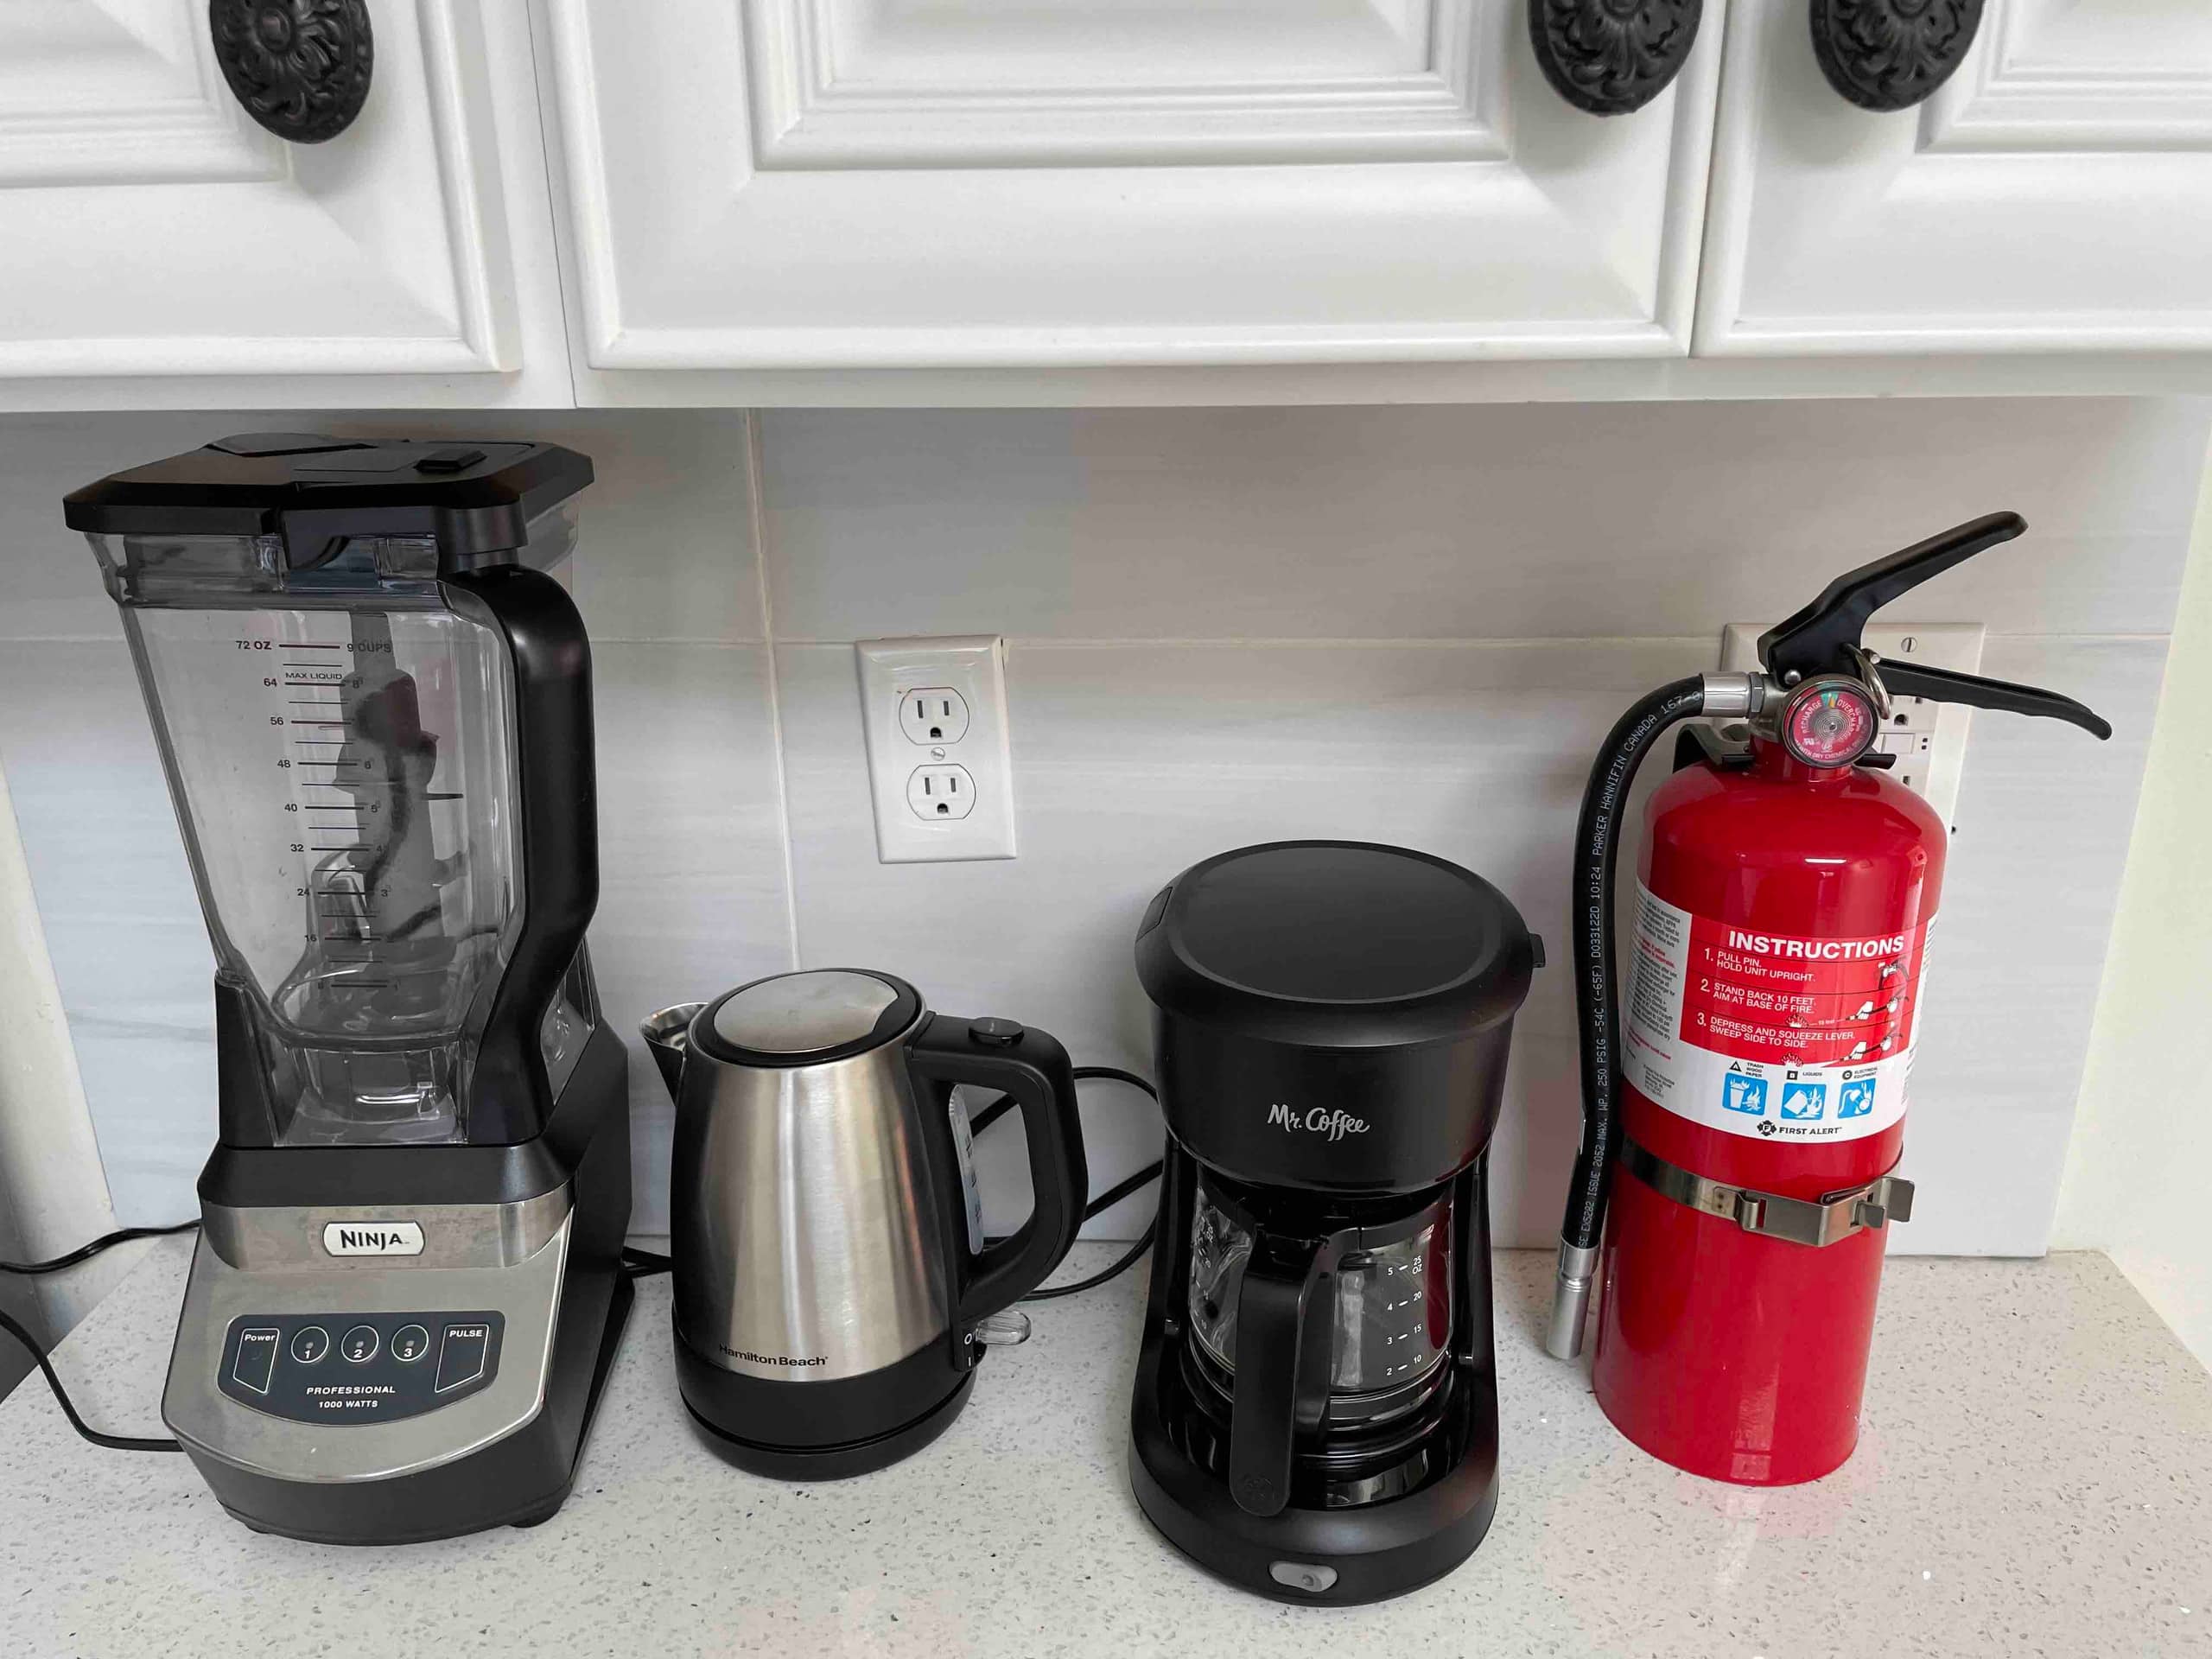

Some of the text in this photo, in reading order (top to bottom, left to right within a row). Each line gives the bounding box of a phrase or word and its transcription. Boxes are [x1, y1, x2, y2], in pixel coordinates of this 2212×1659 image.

[235, 640, 272, 650] 72 OZ
[346, 643, 354, 652] 9
[264, 677, 277, 687] 64
[270, 716, 284, 726] 56
[1624, 714, 1658, 752] CANADA
[276, 760, 291, 768] 48
[364, 761, 372, 770] 6
[1599, 755, 1627, 810] HANNIFIN
[284, 804, 297, 812] 40
[1592, 815, 1608, 856] PARKER
[290, 843, 304, 852] 32
[296, 888, 310, 897] 24
[1590, 867, 1601, 899] 10:24
[1728, 931, 1904, 959] INSTRUCTIONS
[1704, 948, 1762, 968] 1. PULL PIN.
[1717, 960, 1816, 982] HOLD UNIT UPRIGHT.
[1592, 965, 1604, 1001] (-65F)
[1700, 979, 1711, 992] 2.
[1713, 982, 1745, 996] STAND
[1747, 989, 1774, 1002] BACK
[1713, 991, 1730, 1001] AIM
[1732, 995, 1745, 1005] AT
[1746, 998, 1772, 1009] BASE
[1593, 1007, 1605, 1033] -54C
[1697, 1012, 1855, 1040] 3. DEPRESS AND SQUEEZE LEVER.
[1710, 1024, 1742, 1038] SWEEP
[1744, 1033, 1767, 1044] SIDE
[1769, 1037, 1782, 1046] TO
[1597, 1038, 1607, 1064] PSIG
[1598, 1068, 1608, 1087] 250
[1268, 1104, 1370, 1141] Mr. Coffee
[1587, 1170, 1600, 1197] ISSUE
[340, 1230, 403, 1250] NINJA
[1388, 1255, 1422, 1275] 5 25
[1412, 1263, 1422, 1274] OZ
[1387, 1290, 1421, 1311] 4 20
[244, 1333, 276, 1342] Power
[448, 1329, 484, 1338] PULSE
[1387, 1323, 1421, 1345] 3 15
[304, 1350, 311, 1359] 1
[353, 1349, 364, 1358] 2
[404, 1348, 413, 1357] 3
[719, 1343, 826, 1366] Hamilton Beach
[1386, 1353, 1421, 1376] 2 10
[306, 1385, 397, 1395] PROFESSIONAL
[345, 1400, 379, 1408] WATTS
